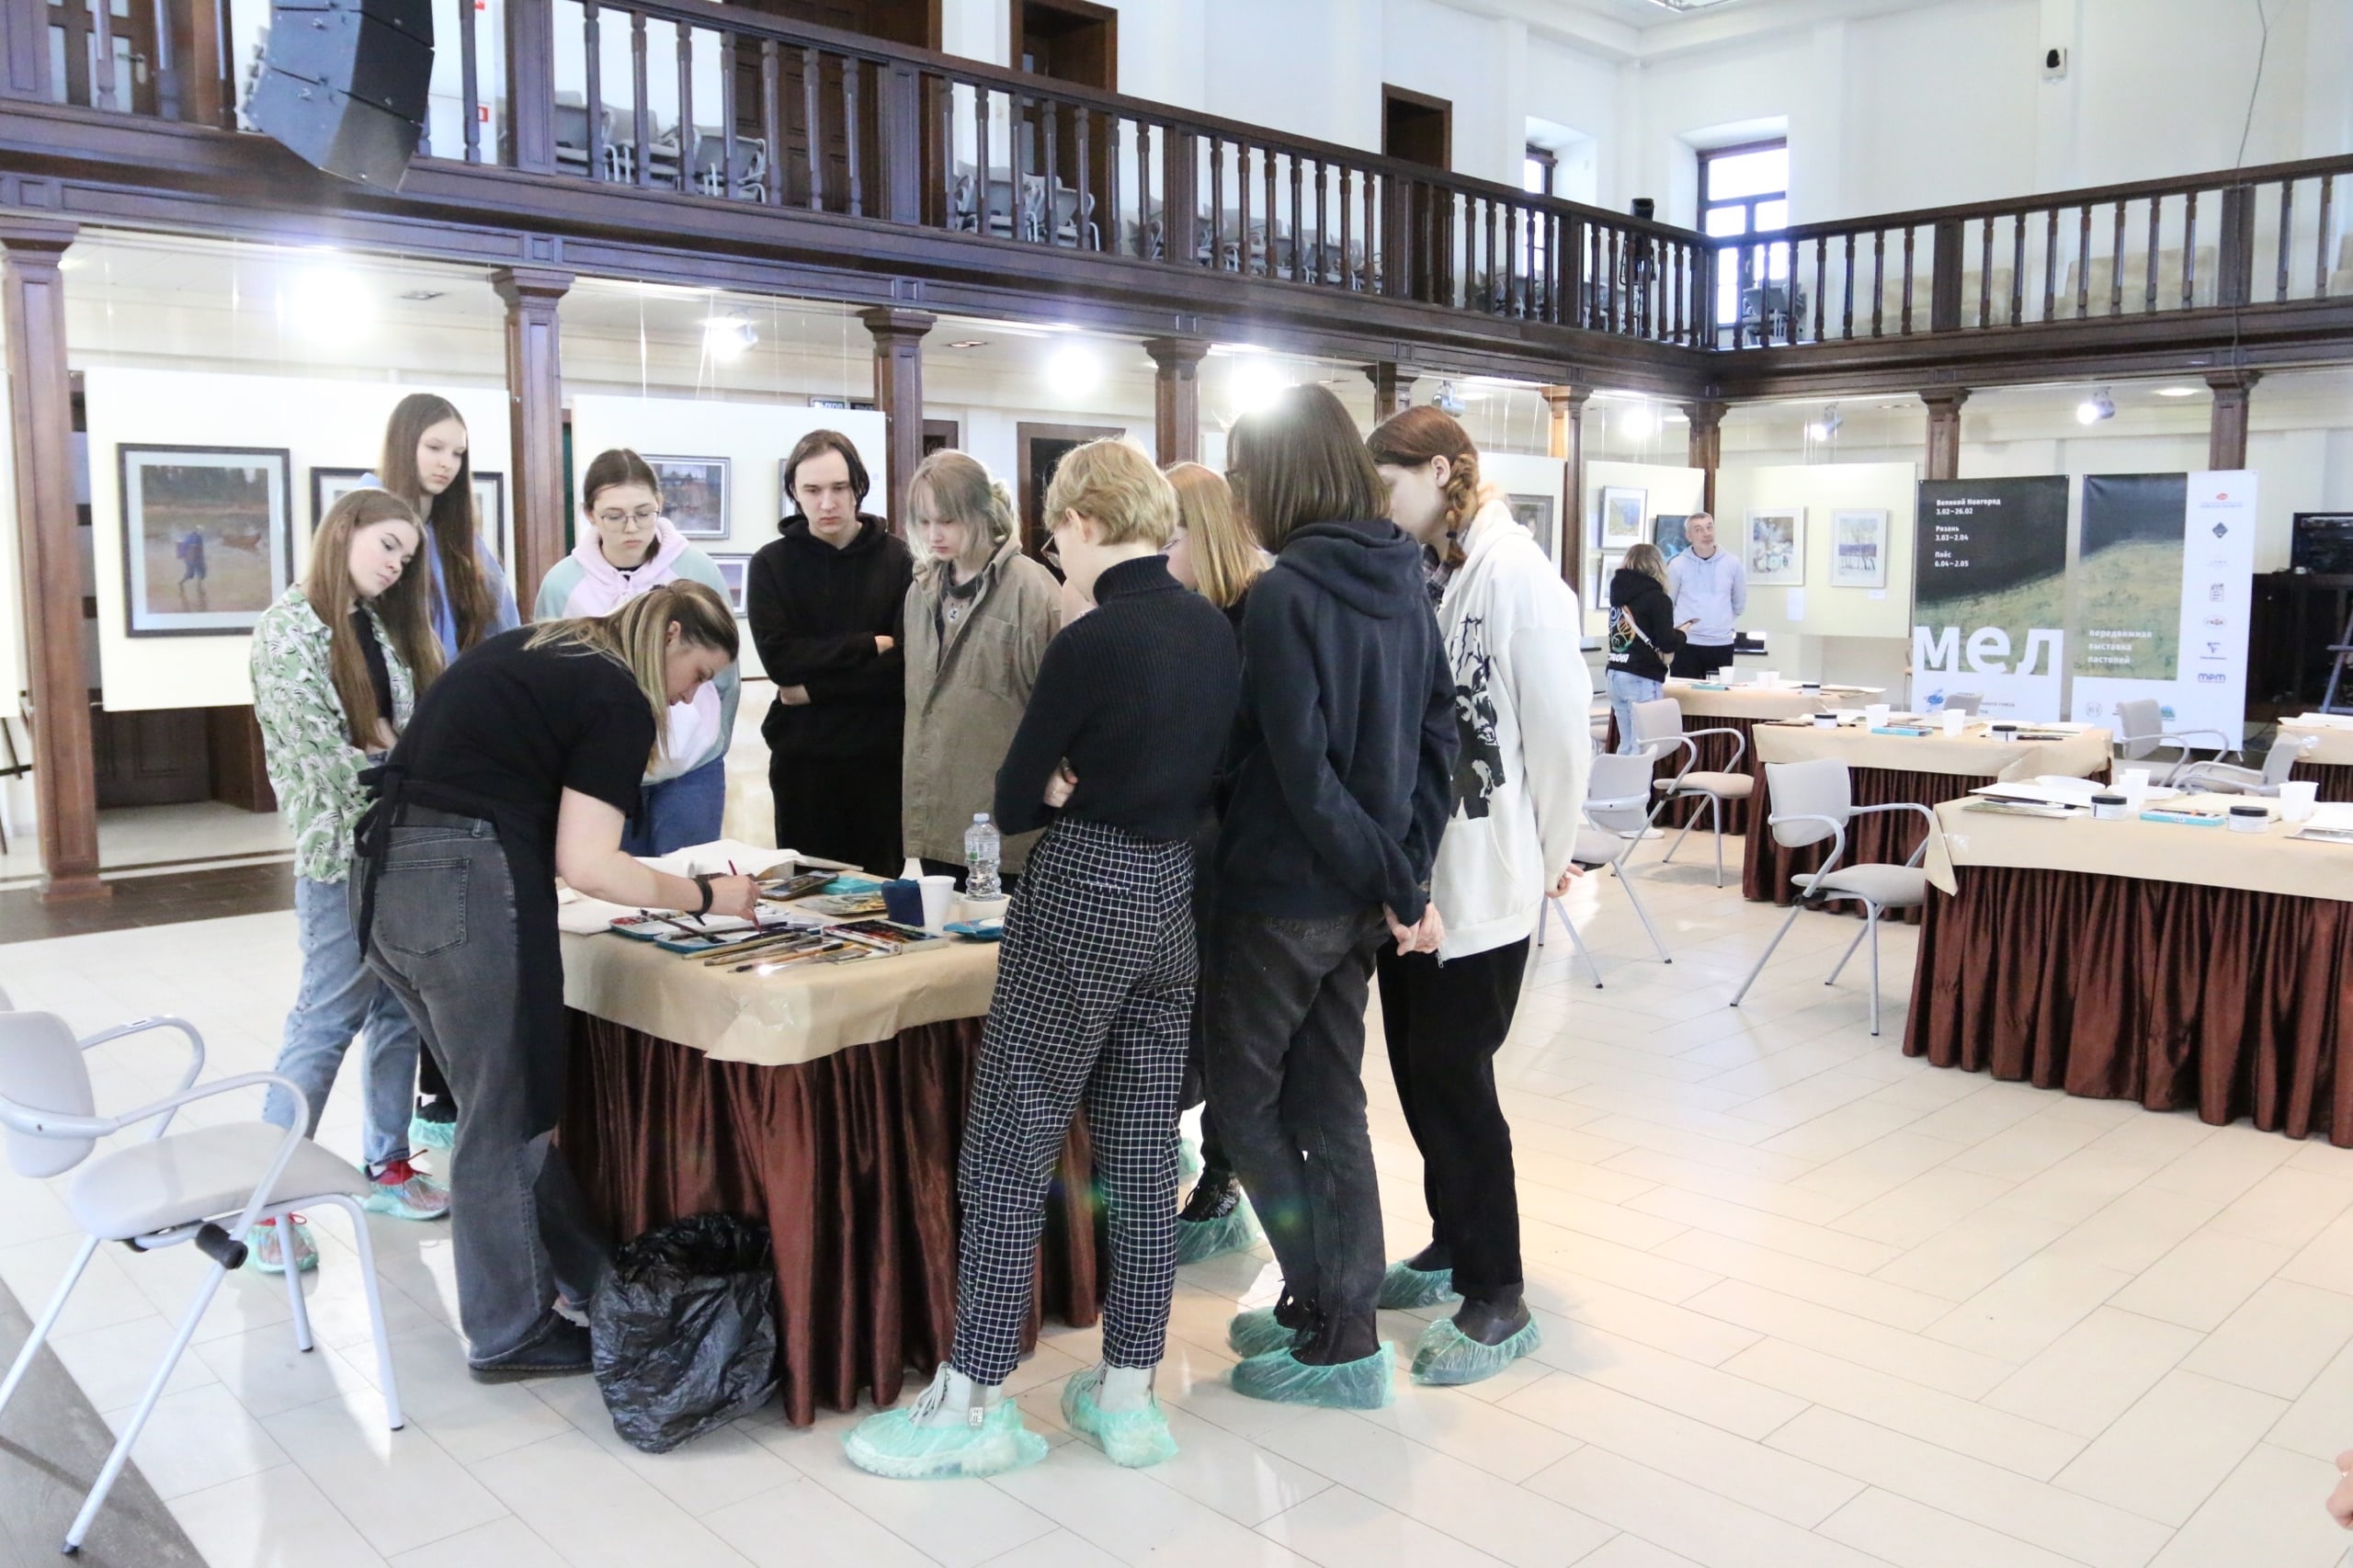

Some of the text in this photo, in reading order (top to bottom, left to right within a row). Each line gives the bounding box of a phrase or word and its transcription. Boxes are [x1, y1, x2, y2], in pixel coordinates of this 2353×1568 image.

[1936, 498, 2001, 506] Великий Новгород
[2089, 630, 2153, 639] передвижная
[1913, 626, 2063, 676] мел
[2087, 654, 2131, 664] пастелей
